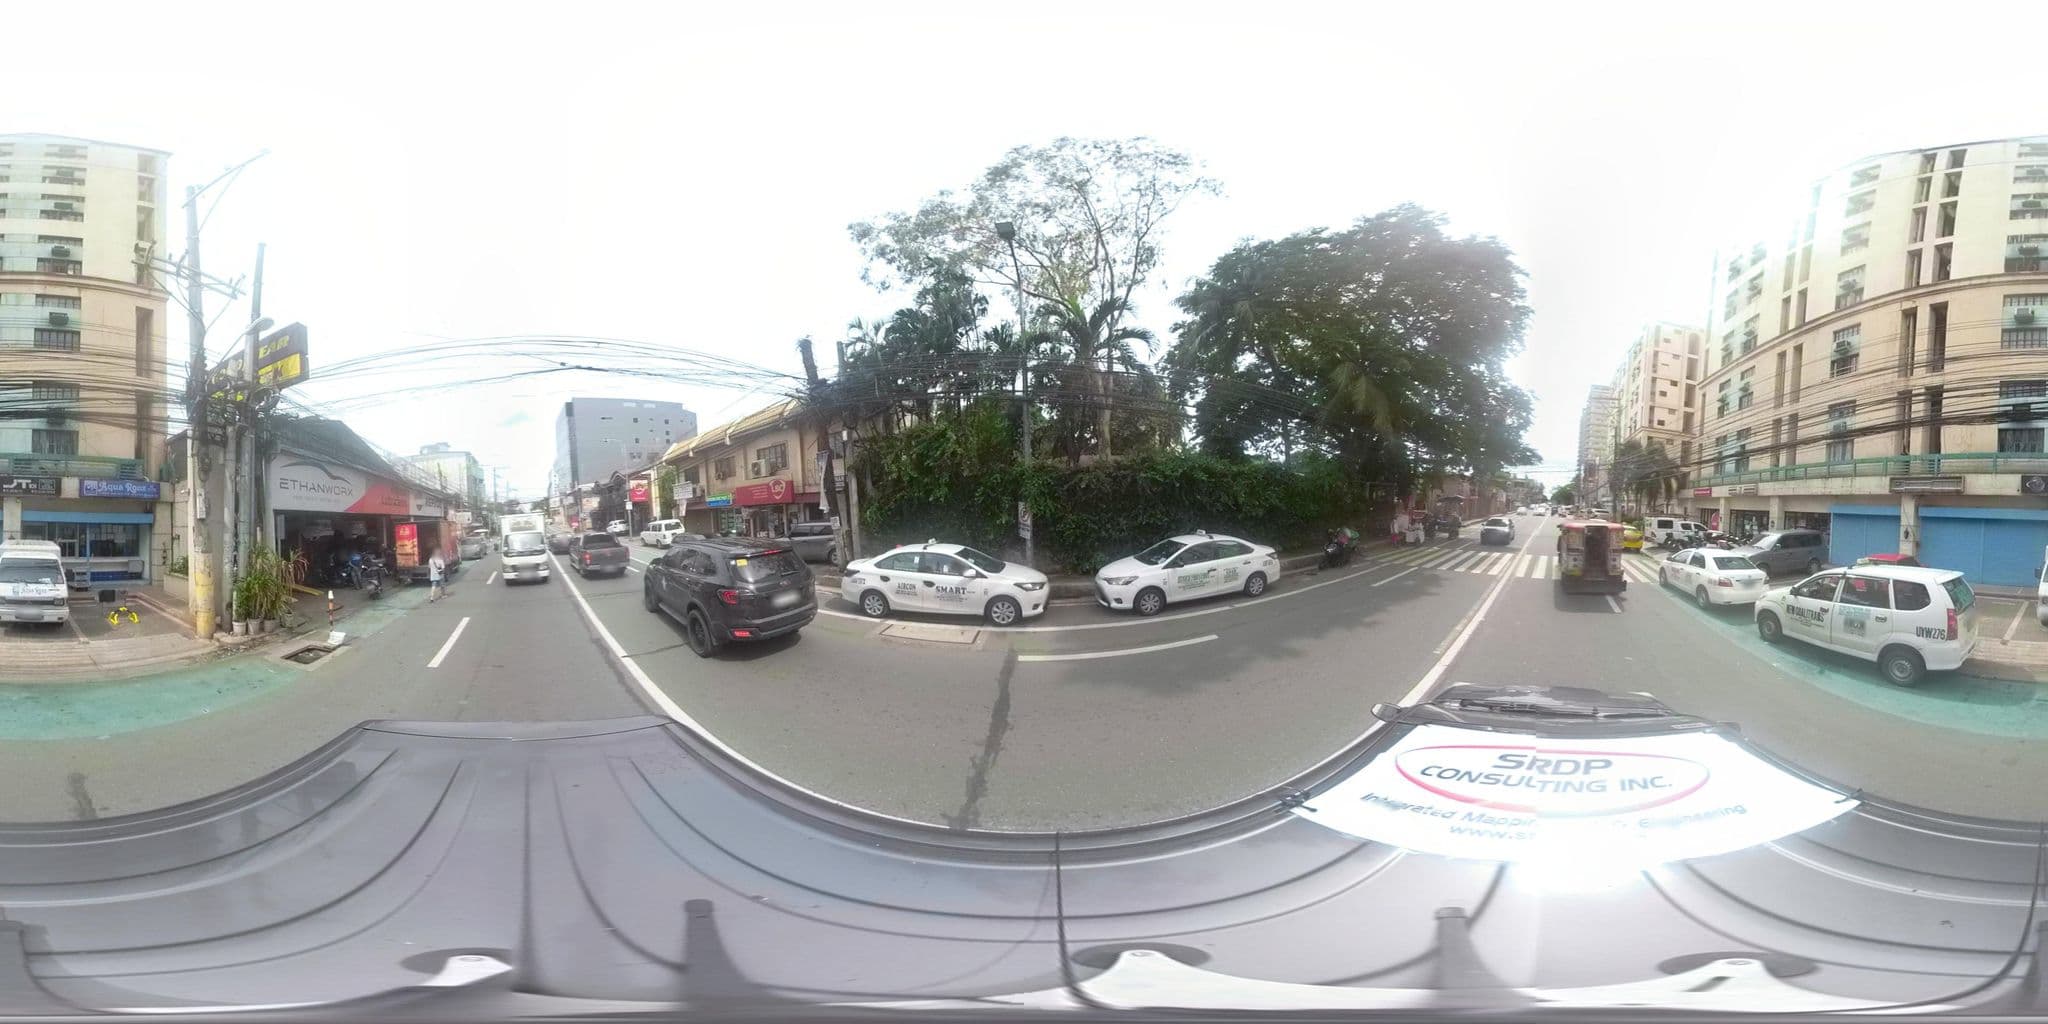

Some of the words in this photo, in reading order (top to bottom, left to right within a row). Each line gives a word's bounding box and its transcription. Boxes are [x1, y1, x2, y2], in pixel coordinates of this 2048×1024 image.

[279, 477, 353, 496] ETHANWORX
[936, 585, 968, 595] SMART
[1491, 753, 1613, 775] SRDP
[1419, 765, 1608, 793] CONSULTING
[1619, 776, 1673, 792] INC.
